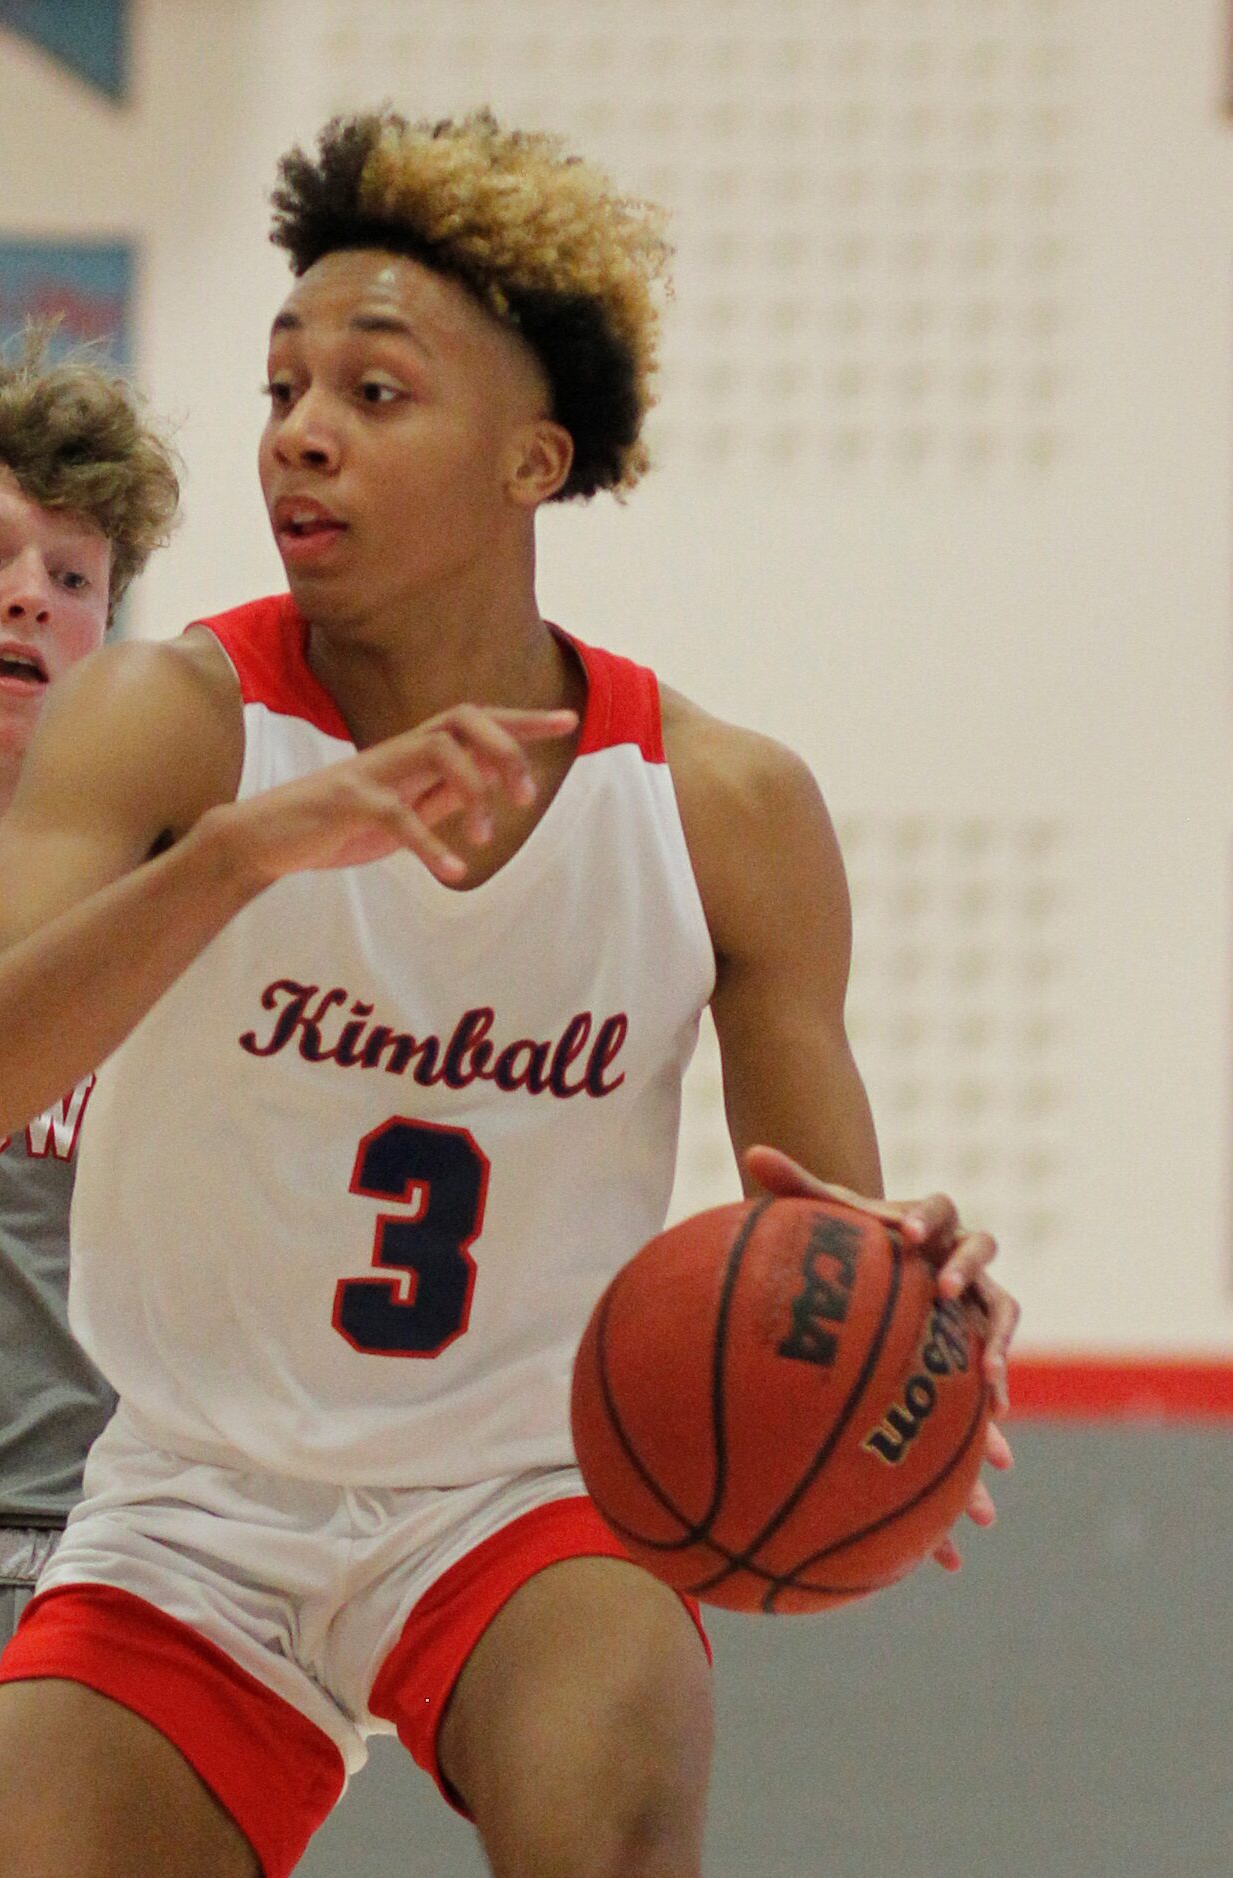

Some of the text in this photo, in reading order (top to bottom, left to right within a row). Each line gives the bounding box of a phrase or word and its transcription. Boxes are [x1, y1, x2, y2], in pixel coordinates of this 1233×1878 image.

[239, 979, 629, 1099] Kimball
[331, 1114, 491, 1360] 3
[777, 1212, 864, 1368] NCAA
